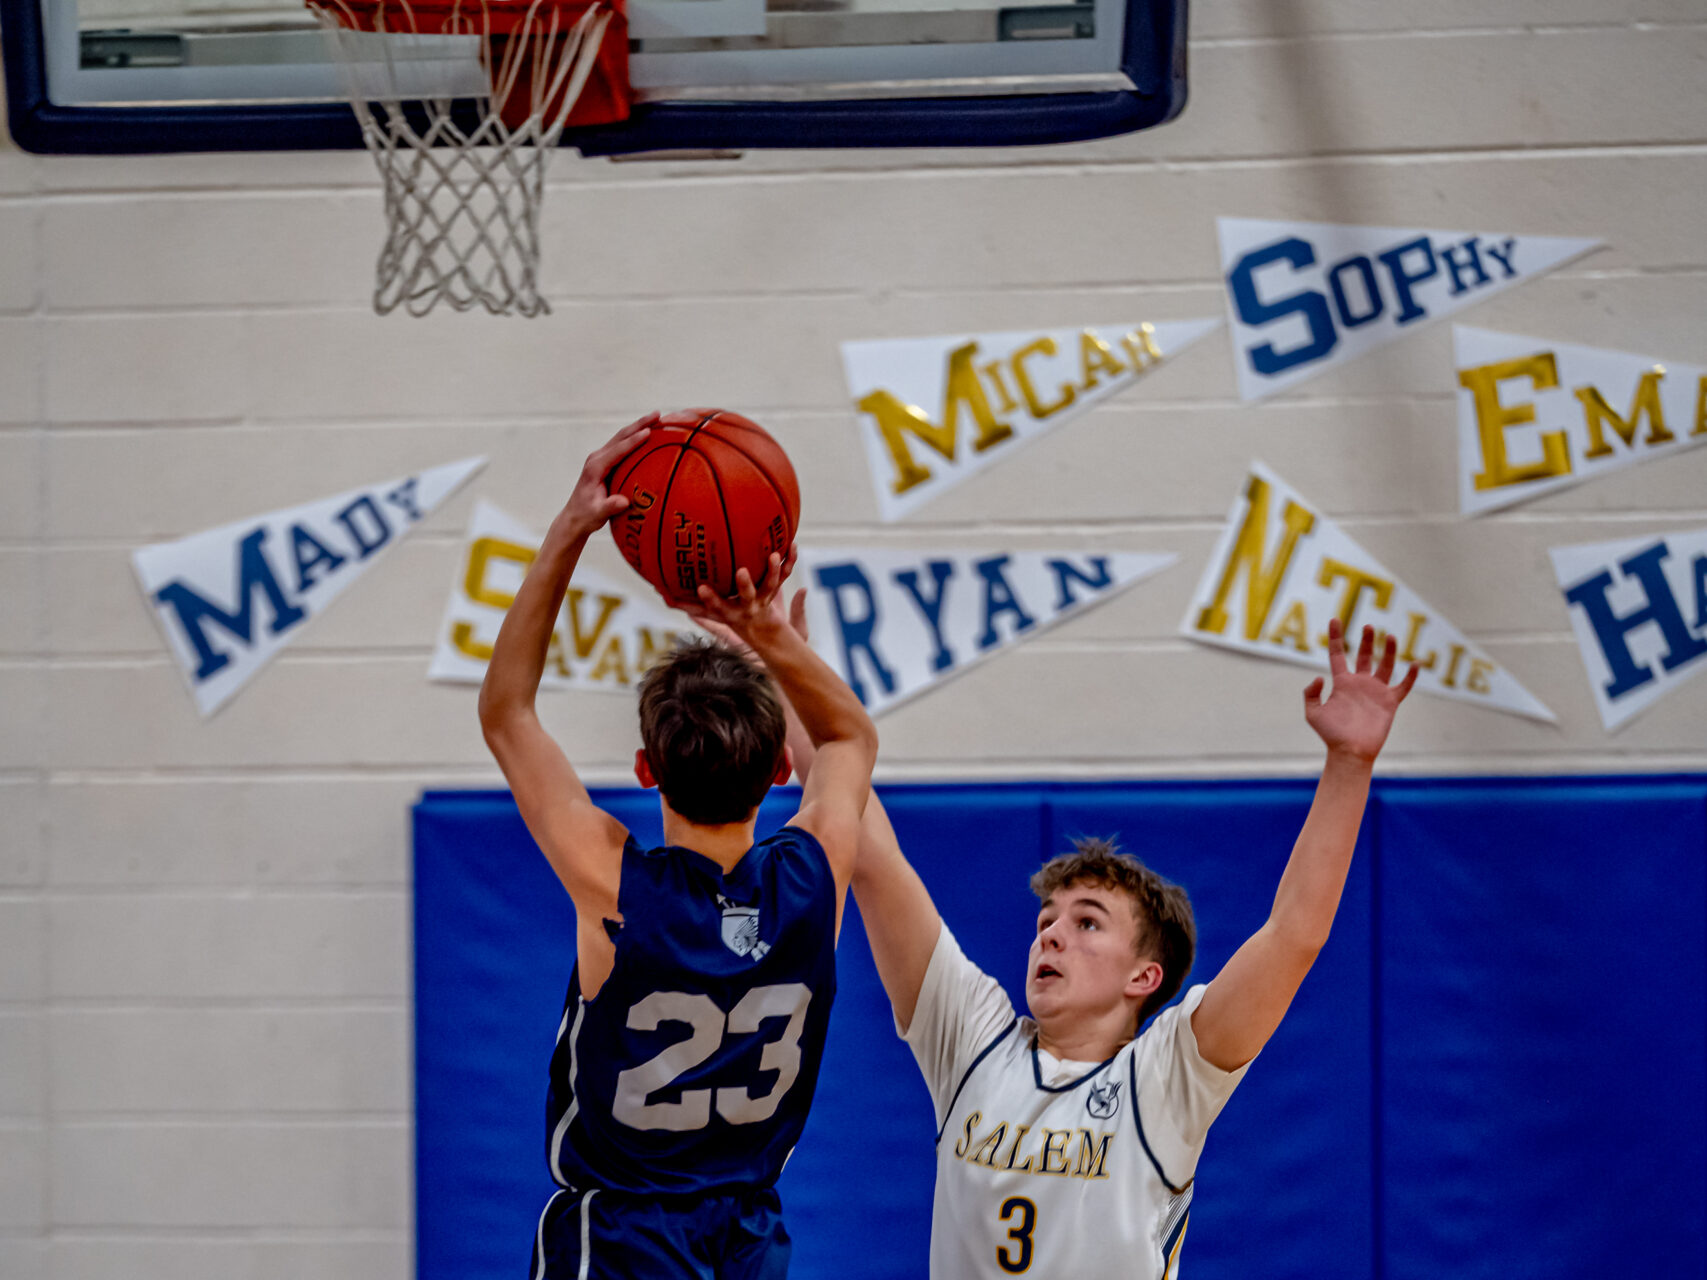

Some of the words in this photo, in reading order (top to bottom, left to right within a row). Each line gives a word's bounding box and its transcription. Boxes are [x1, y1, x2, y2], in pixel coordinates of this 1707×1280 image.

[1226, 236, 1518, 376] SOPHY
[153, 478, 423, 684] MADY
[812, 554, 1112, 706] RYAN
[612, 982, 812, 1131] 23
[955, 1111, 1114, 1179] SALEM
[996, 1195, 1037, 1274] 3
